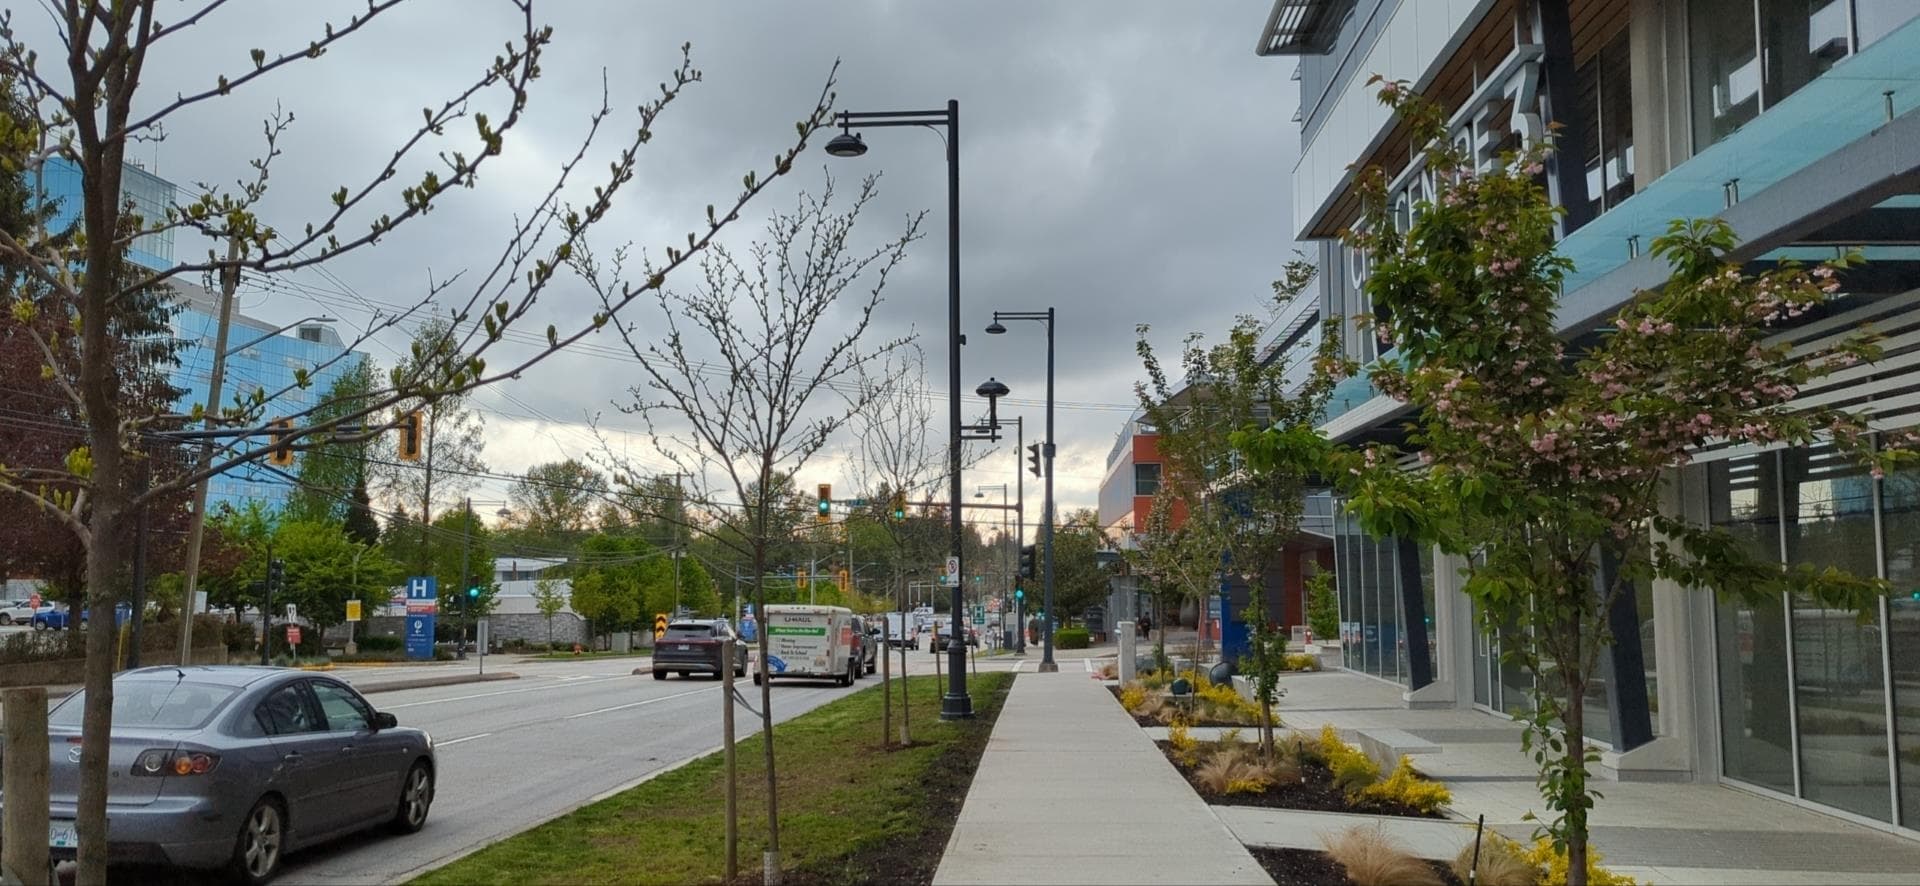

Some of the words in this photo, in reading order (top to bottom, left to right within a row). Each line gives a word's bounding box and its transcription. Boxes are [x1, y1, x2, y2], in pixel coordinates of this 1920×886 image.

[1503, 61, 1543, 179] 3
[412, 579, 427, 598] H
[974, 606, 983, 617] H
